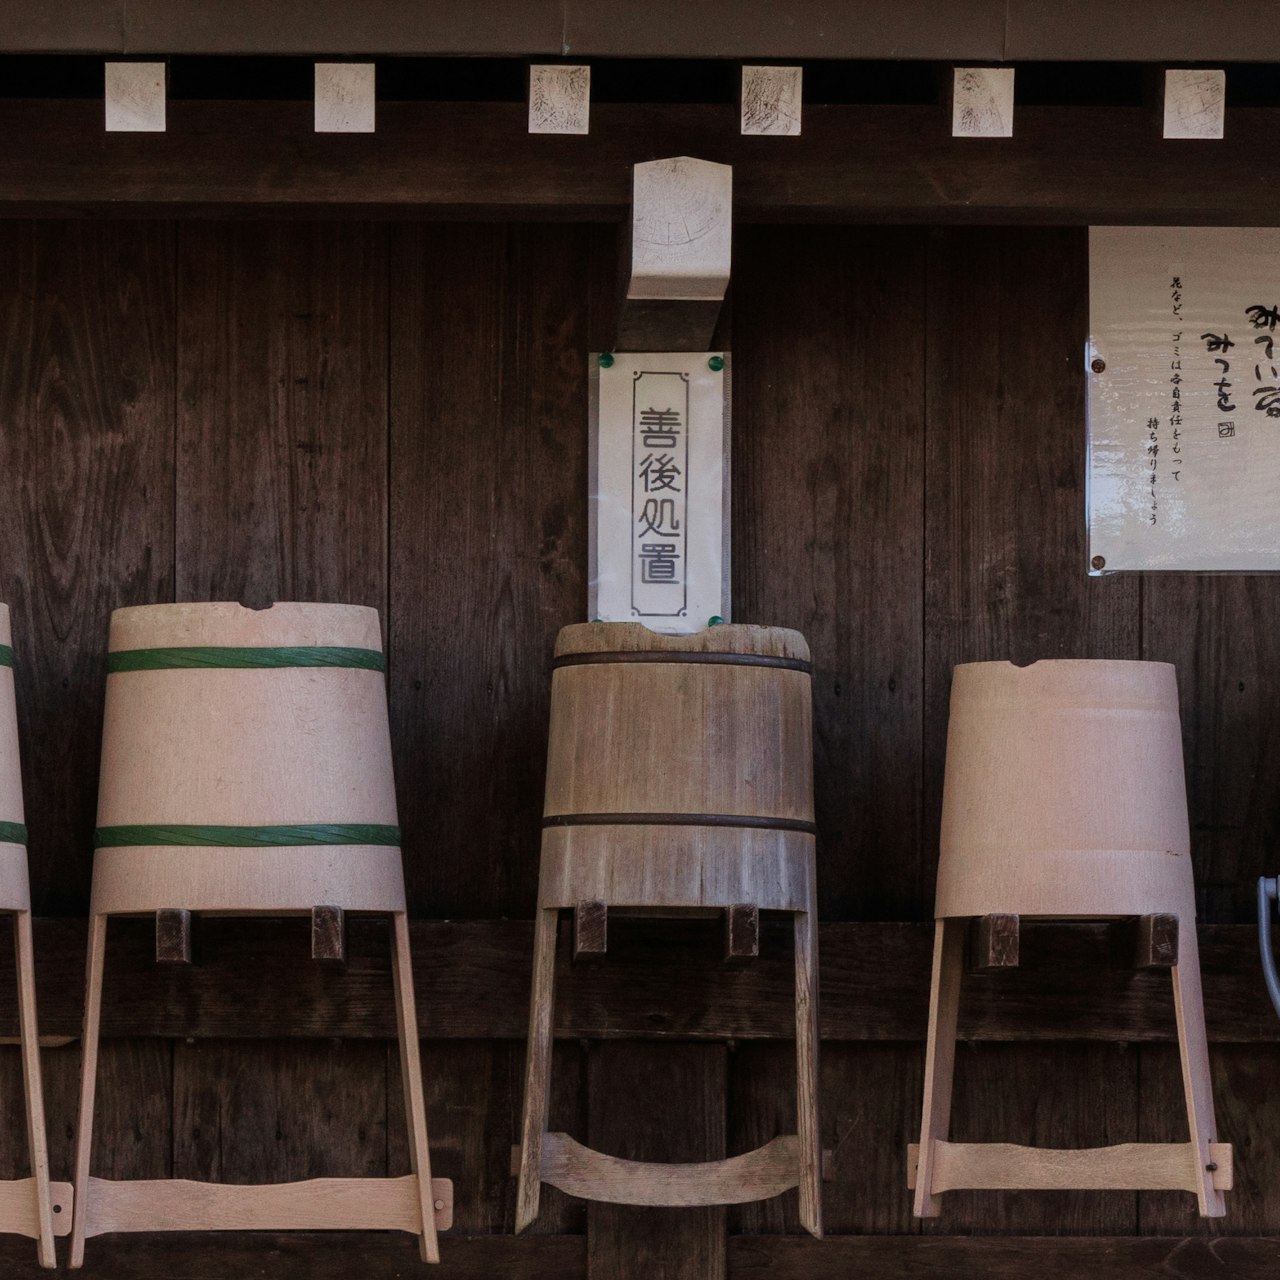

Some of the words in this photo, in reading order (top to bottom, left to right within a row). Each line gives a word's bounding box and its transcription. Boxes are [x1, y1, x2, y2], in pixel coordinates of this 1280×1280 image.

[1200, 332, 1236, 412] みつを
[638, 407, 682, 585] 善後処置
[1147, 417, 1160, 526] 持ち帰りましょう
